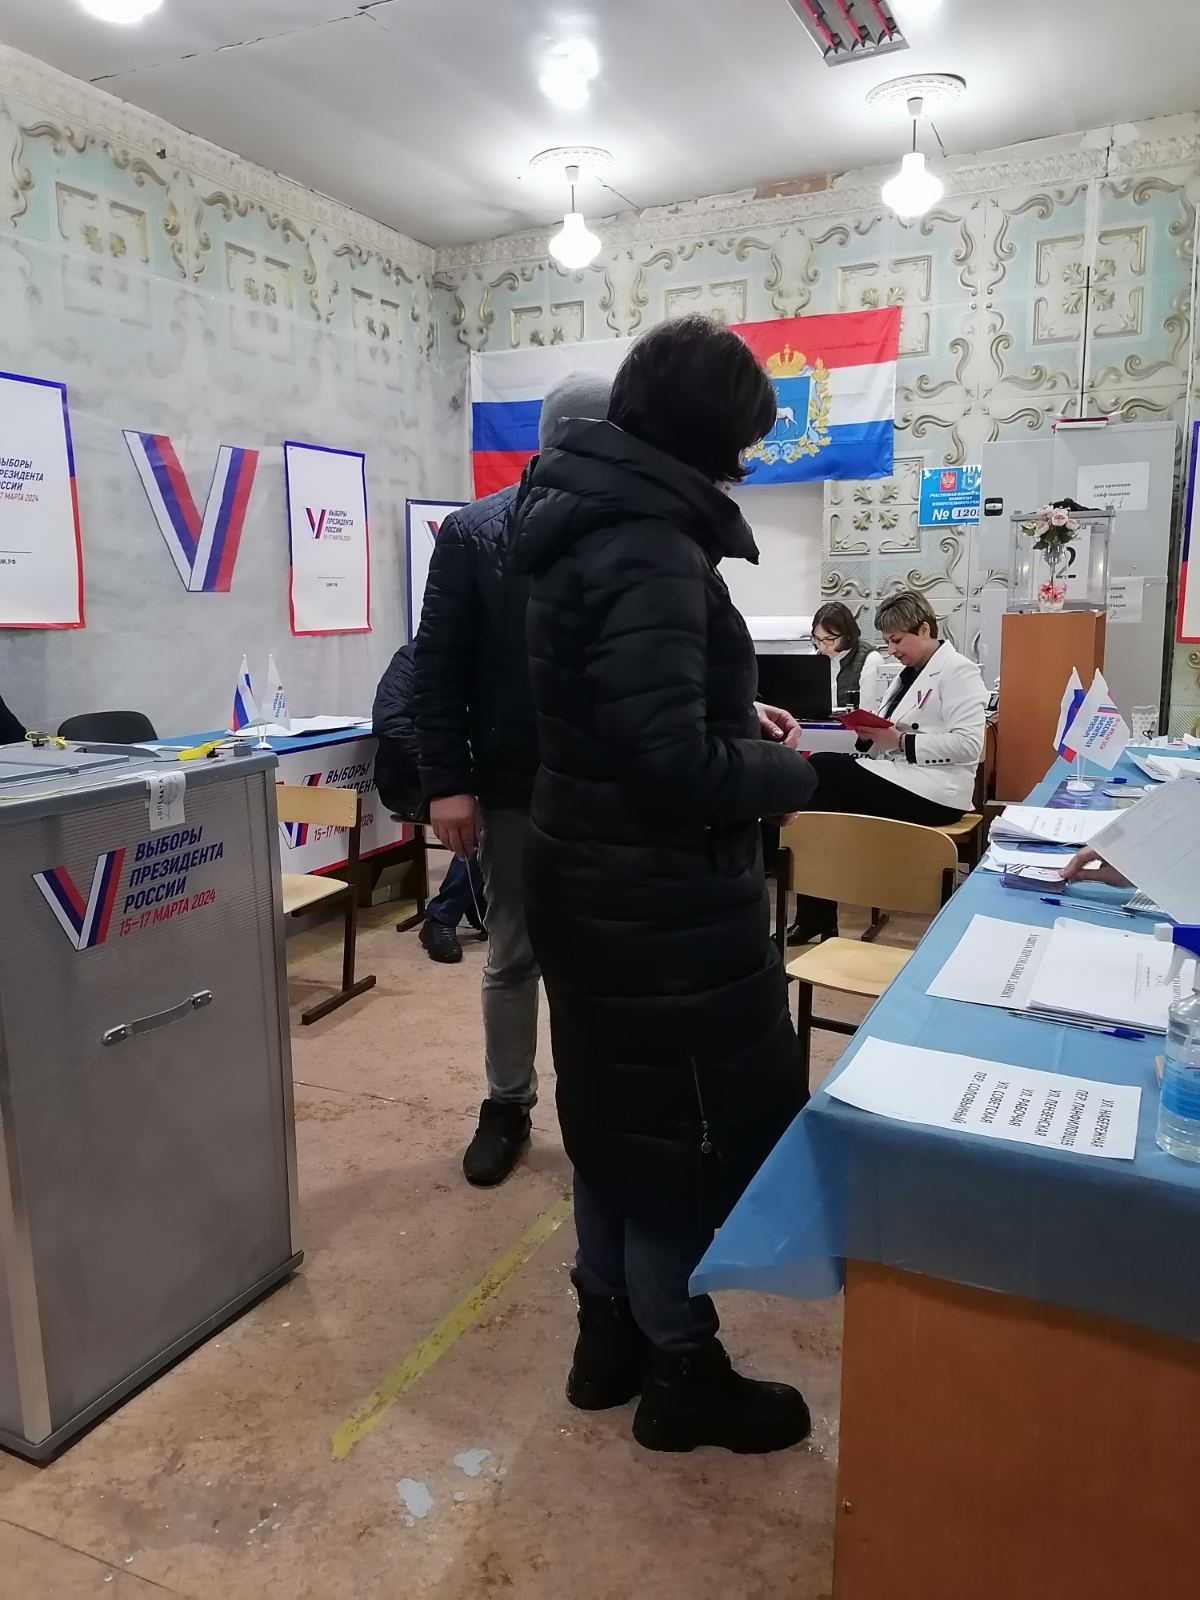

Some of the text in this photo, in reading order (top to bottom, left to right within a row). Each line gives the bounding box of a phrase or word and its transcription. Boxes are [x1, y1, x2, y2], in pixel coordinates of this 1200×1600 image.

[0, 457, 33, 469] ЫБОРЫ
[0, 469, 44, 481] РЕЗИДЕНТА
[0, 481, 23, 491] ССИИ
[931, 508, 980, 521] № 120
[325, 762, 371, 785] ВЫБОРЫ
[134, 826, 203, 862] ВЫБОРЫ
[129, 842, 224, 888] ПРЕЗИДЕНТА
[123, 876, 187, 914] РОССИИ
[152, 897, 189, 925] МАРТА
[191, 888, 216, 910] 2024
[951, 1082, 981, 1124] СОЛОВЬИНЫЙ
[980, 1090, 1005, 1124] СОВЕТСКАЯ
[1008, 1097, 1030, 1127] РАБОЧАЯ
[1034, 1098, 1058, 1137] ПЕНЗЕНСКАЯ
[1061, 1101, 1085, 1146] ПАНФИЛОВЦЕВ
[1091, 1108, 1112, 1148] НАБЕРЕЖНАЯ
